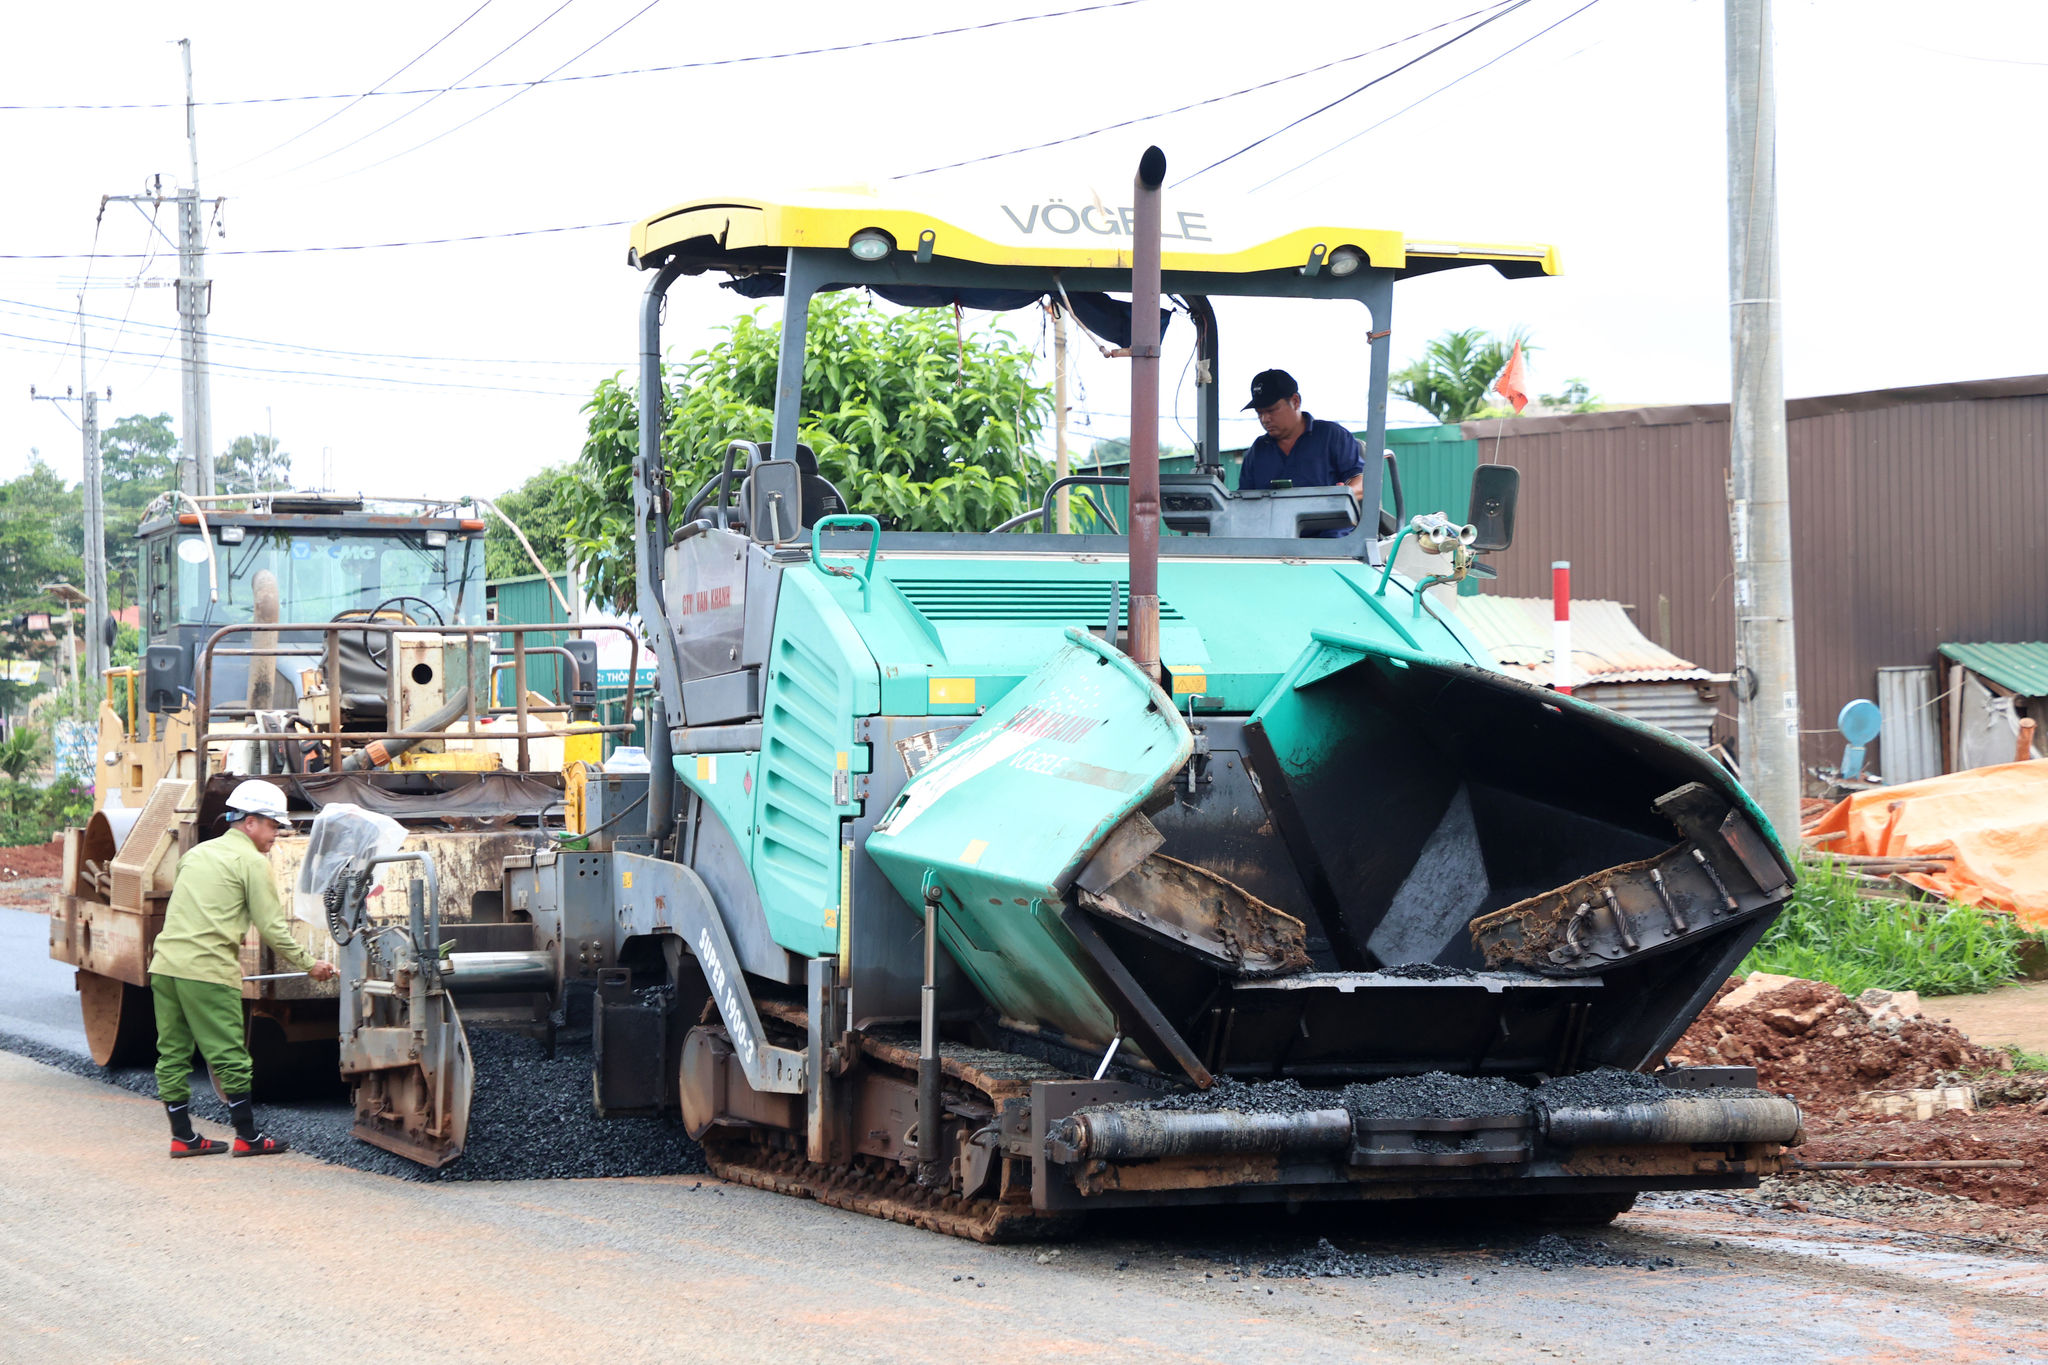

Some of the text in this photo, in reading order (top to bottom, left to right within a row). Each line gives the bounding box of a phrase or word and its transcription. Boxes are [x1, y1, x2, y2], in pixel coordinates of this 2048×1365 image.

[313, 545, 377, 560] XCMG
[698, 927, 754, 1064] SUPER 1900-3
